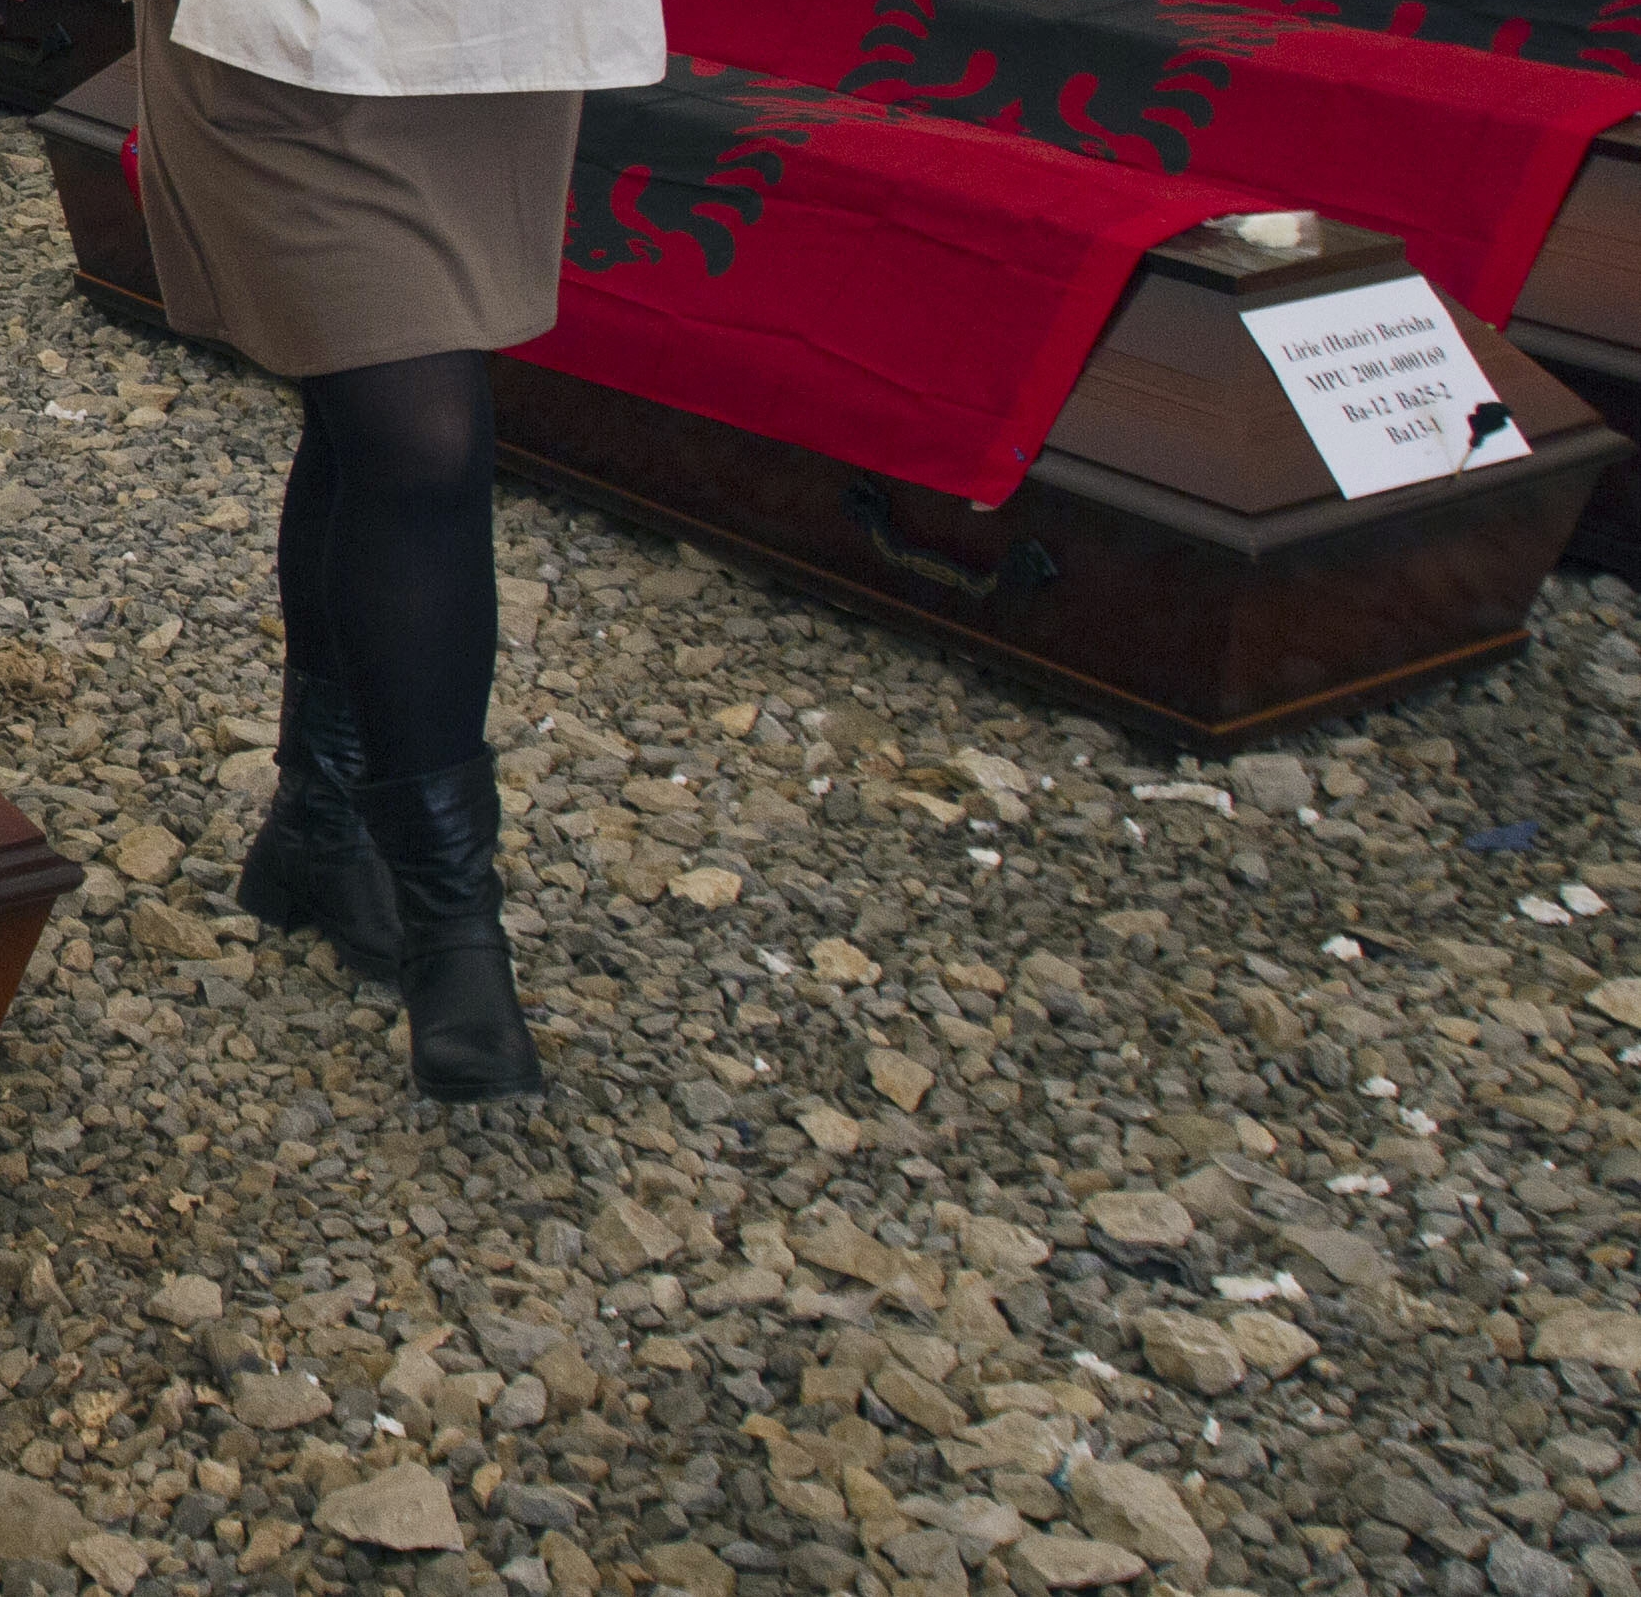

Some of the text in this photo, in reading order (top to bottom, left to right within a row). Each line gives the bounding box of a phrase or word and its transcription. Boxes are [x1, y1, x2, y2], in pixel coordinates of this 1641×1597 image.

[1280, 314, 1436, 364] Lirie (Hazir) Berisha
[1306, 367, 1353, 394] MPU
[1341, 395, 1392, 424] Ba-12
